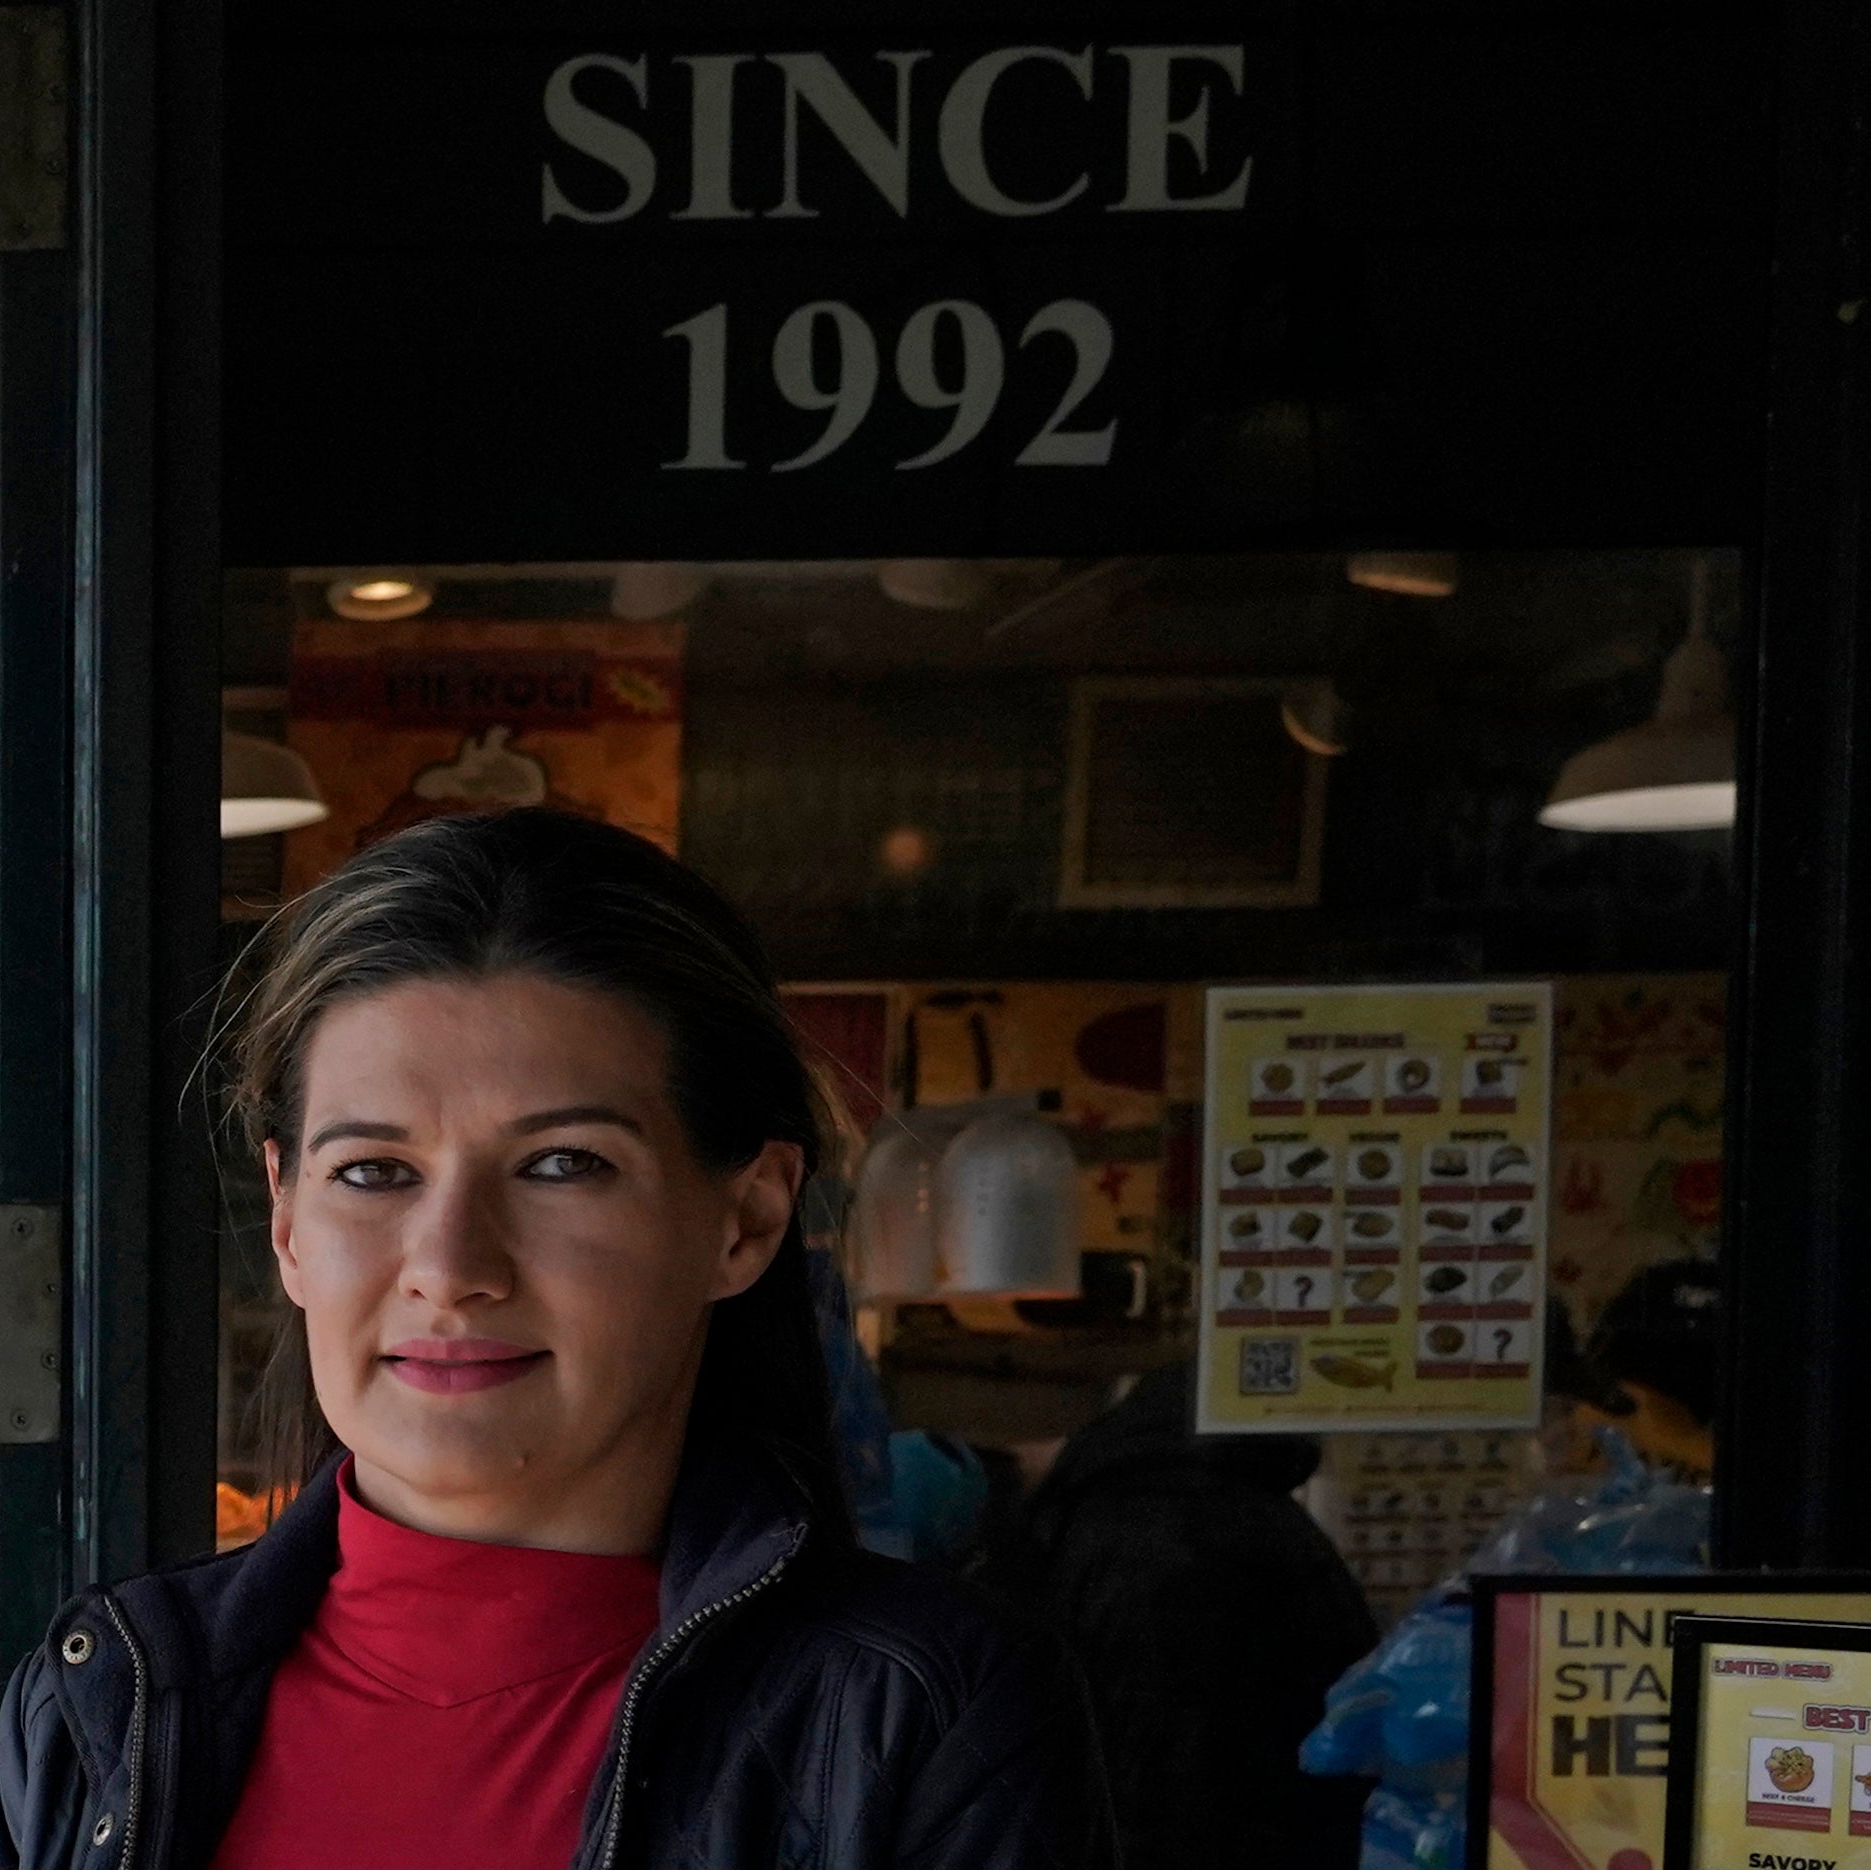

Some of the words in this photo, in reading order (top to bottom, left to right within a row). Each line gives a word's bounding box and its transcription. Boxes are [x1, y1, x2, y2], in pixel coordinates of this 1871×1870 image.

[542, 44, 1254, 225] SINCE
[661, 299, 1119, 473] 1992
[1805, 1705, 1871, 1732] BEST
